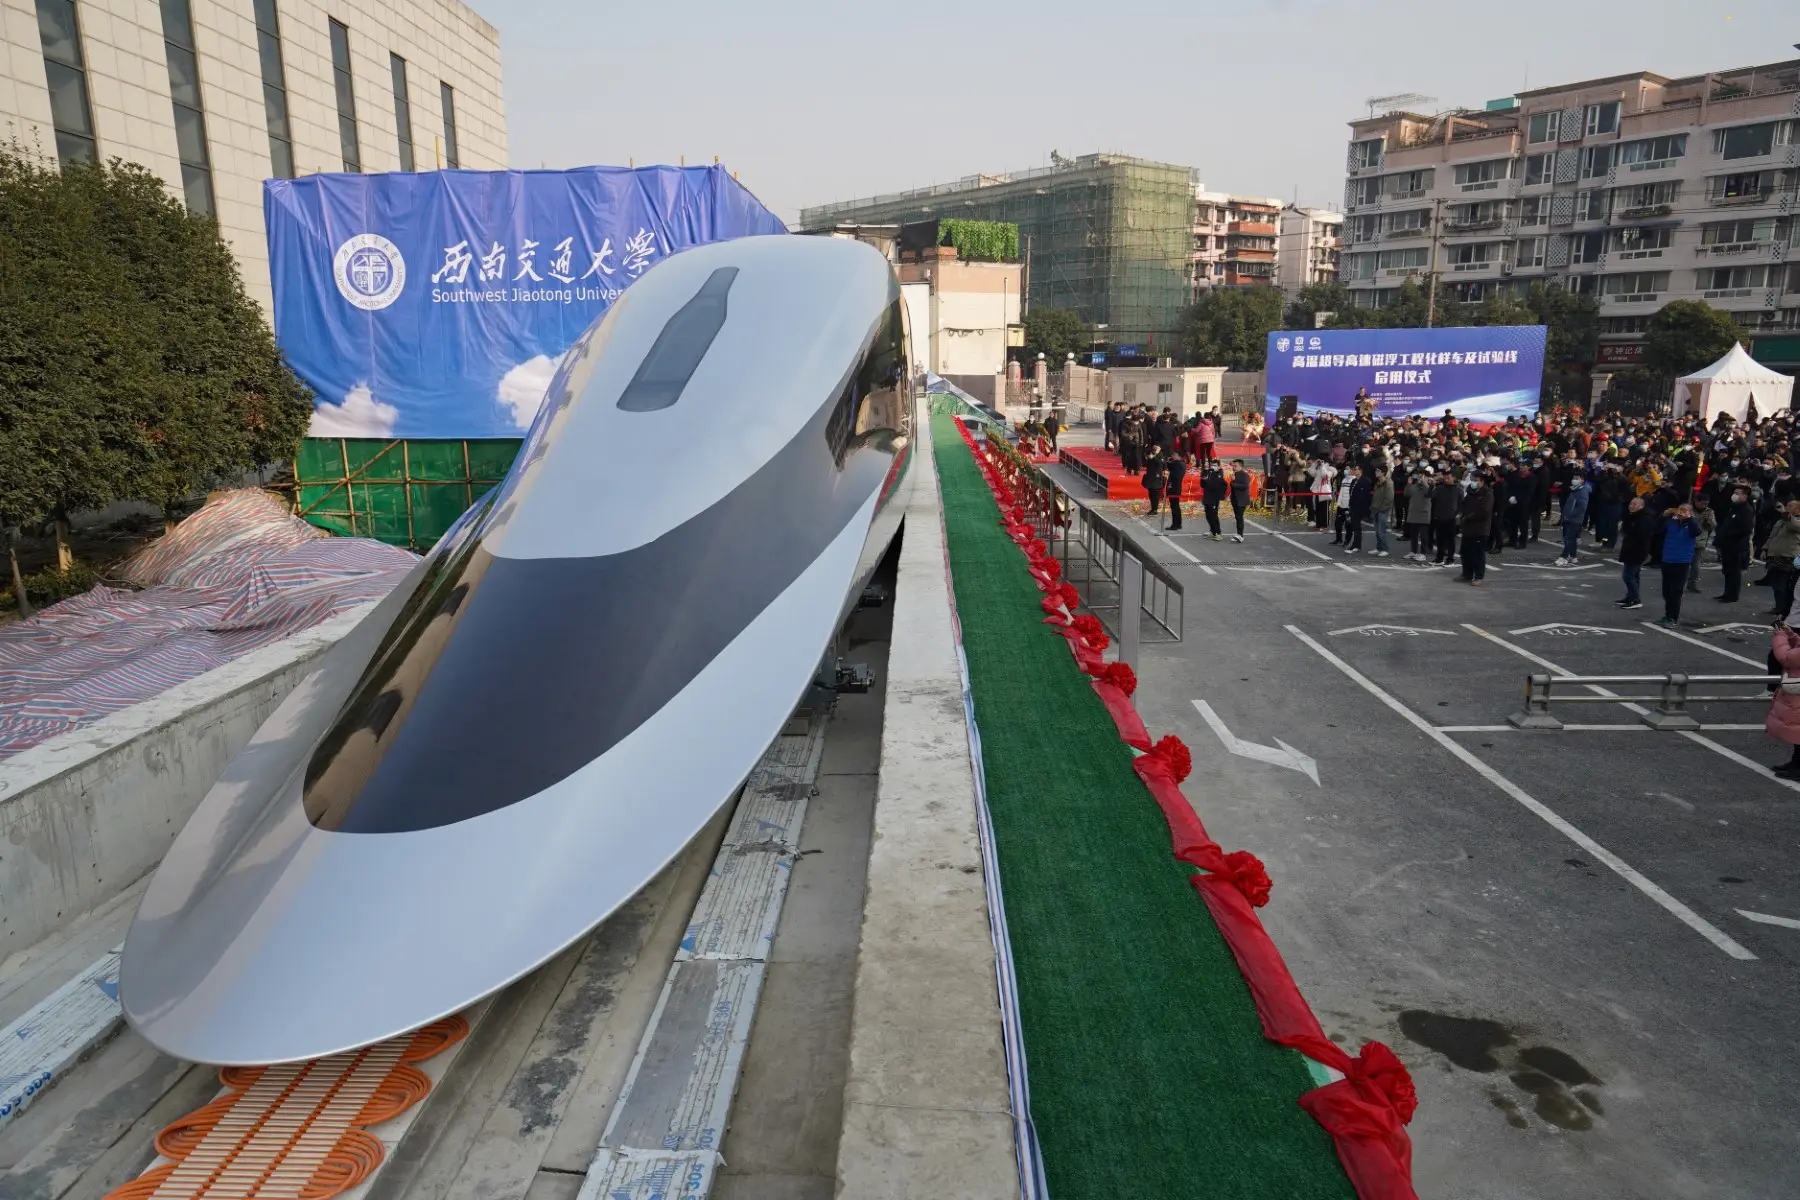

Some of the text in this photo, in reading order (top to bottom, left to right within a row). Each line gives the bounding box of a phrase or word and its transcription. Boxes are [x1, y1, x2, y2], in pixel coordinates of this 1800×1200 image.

[432, 288, 507, 303] Southwest
[511, 287, 572, 304] Jiaotong
[1292, 351, 1518, 368] 高温超导高速磁浮工程化样车及试验线
[1375, 369, 1432, 385] 启用仪式
